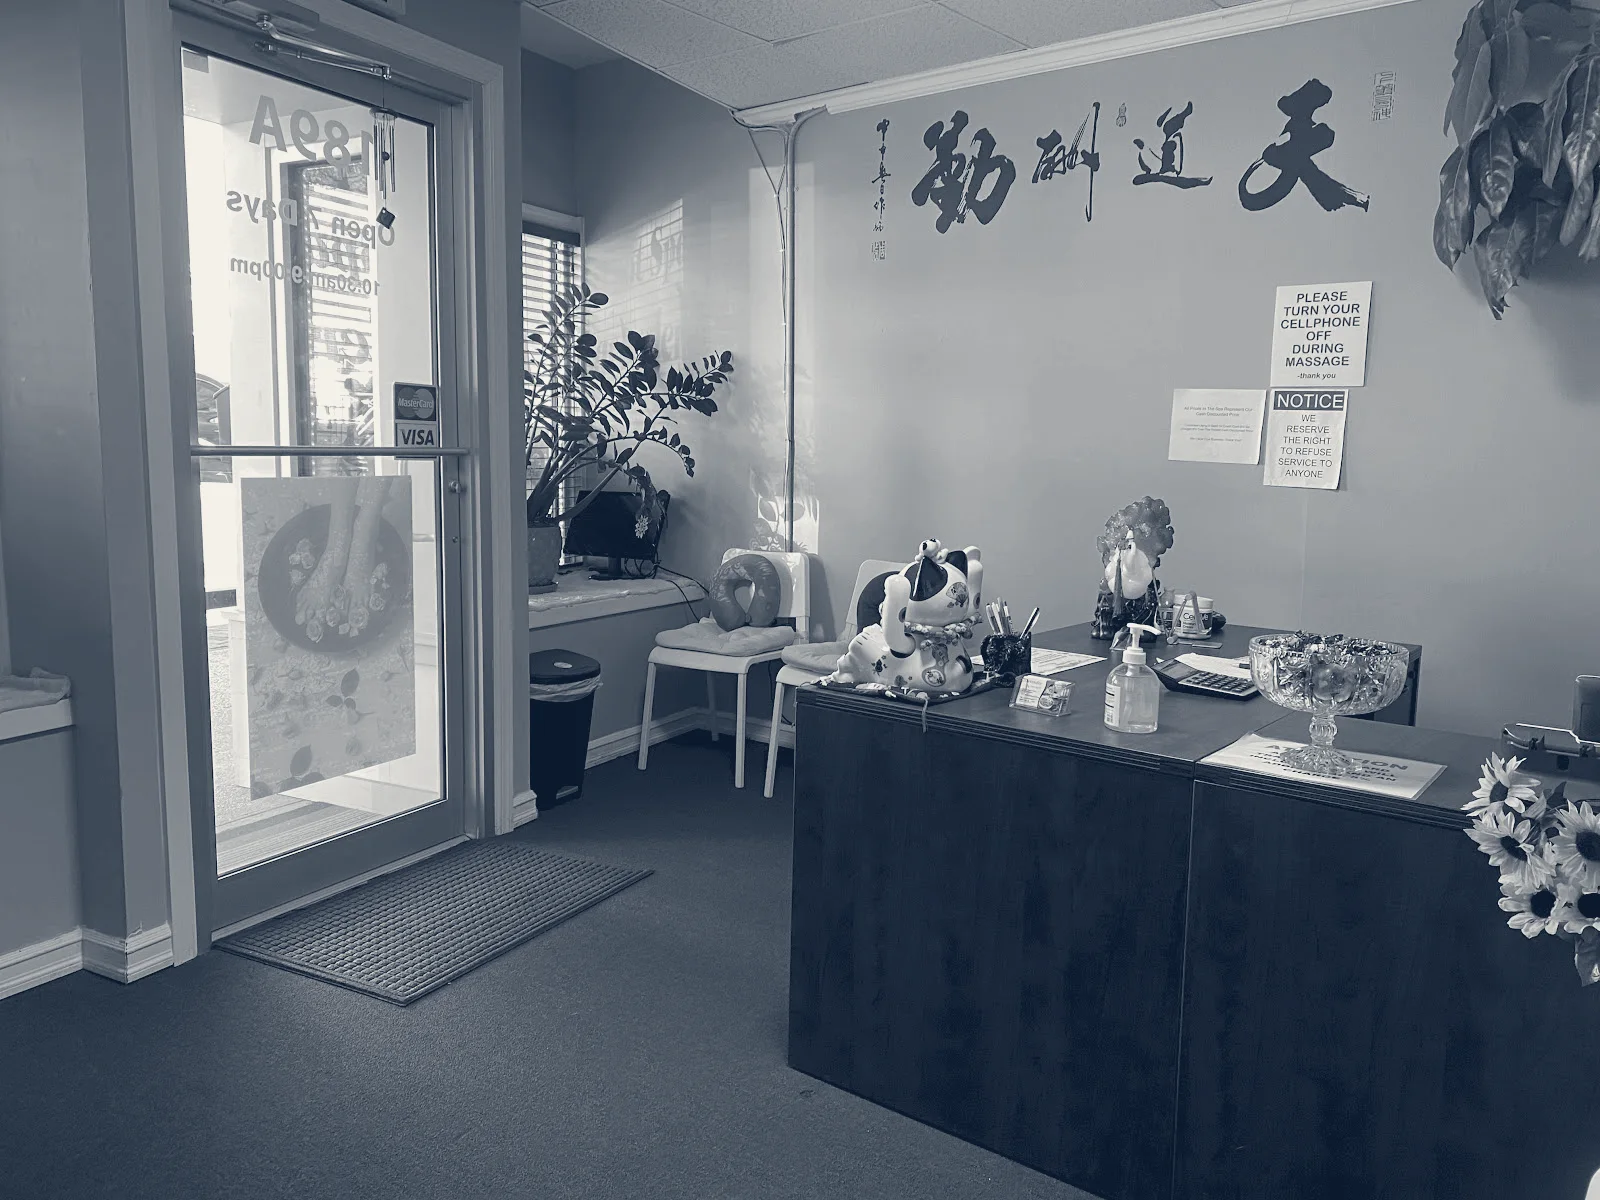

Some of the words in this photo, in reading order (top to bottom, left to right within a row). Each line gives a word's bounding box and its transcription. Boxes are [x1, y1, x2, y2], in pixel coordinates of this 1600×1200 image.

[1296, 290, 1348, 303] PLEASE
[1284, 305, 1319, 317] TURN
[1323, 303, 1360, 315] YOUR
[1280, 316, 1361, 329] CELLPHONE
[1306, 331, 1332, 341] OFF
[1292, 343, 1344, 354] DURING
[1285, 356, 1350, 367] MASSAGE
[398, 397, 433, 408] MasterCard
[1277, 393, 1344, 408] NOTICE
[1301, 414, 1316, 422] WE
[1286, 425, 1330, 434] RESERVE
[399, 429, 434, 445] VISA
[1283, 436, 1301, 444] THE
[1303, 436, 1332, 445] RIGHT
[1280, 447, 1294, 455] TO
[1295, 447, 1332, 456] REFUSE
[1278, 458, 1317, 467] SERVICE
[1320, 459, 1333, 467] TO
[1285, 469, 1324, 478] ANYONE
